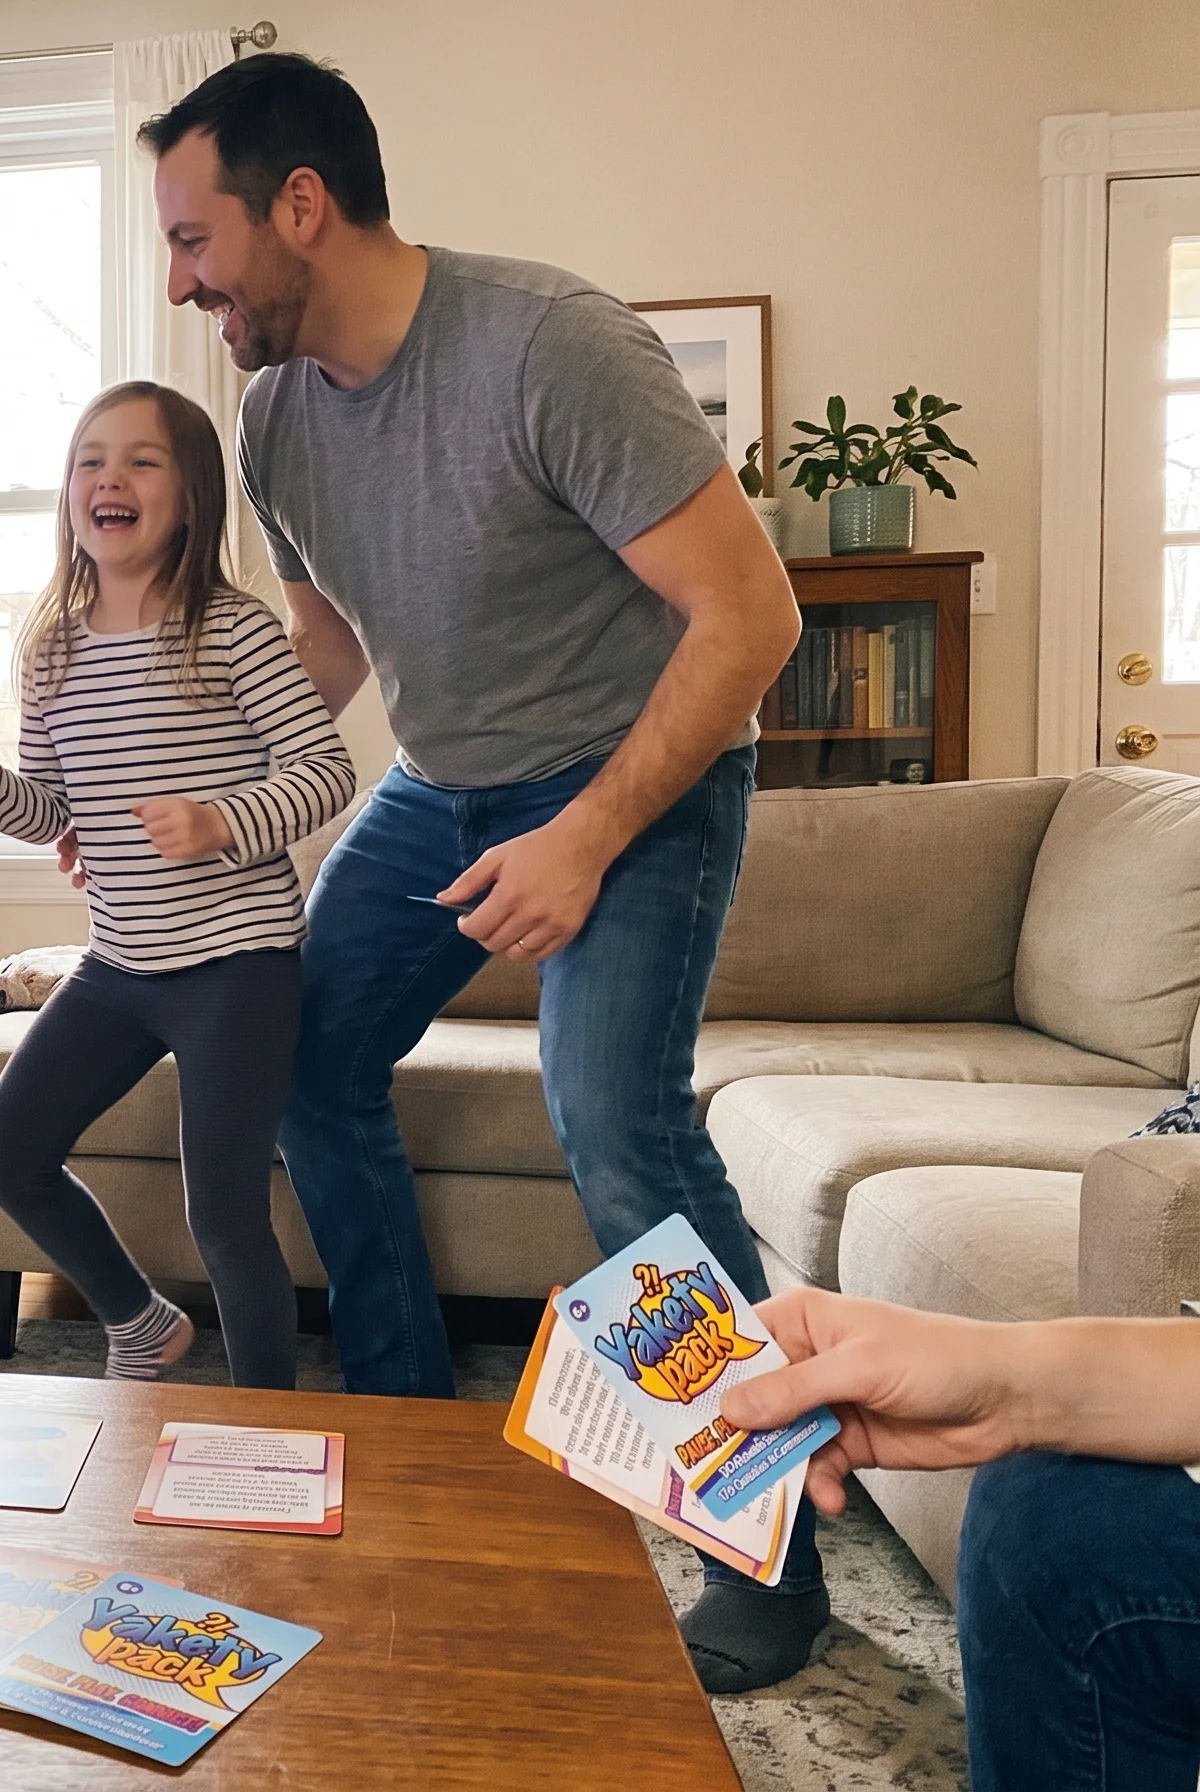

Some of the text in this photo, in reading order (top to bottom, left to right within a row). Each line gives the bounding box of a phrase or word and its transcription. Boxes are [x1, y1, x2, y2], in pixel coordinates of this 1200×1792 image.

[595, 1261, 730, 1381] Yakety
[632, 1263, 664, 1297] ?!
[655, 1320, 735, 1405] pack
[82, 1597, 283, 1680] Yakety
[92, 1636, 216, 1687] pack
